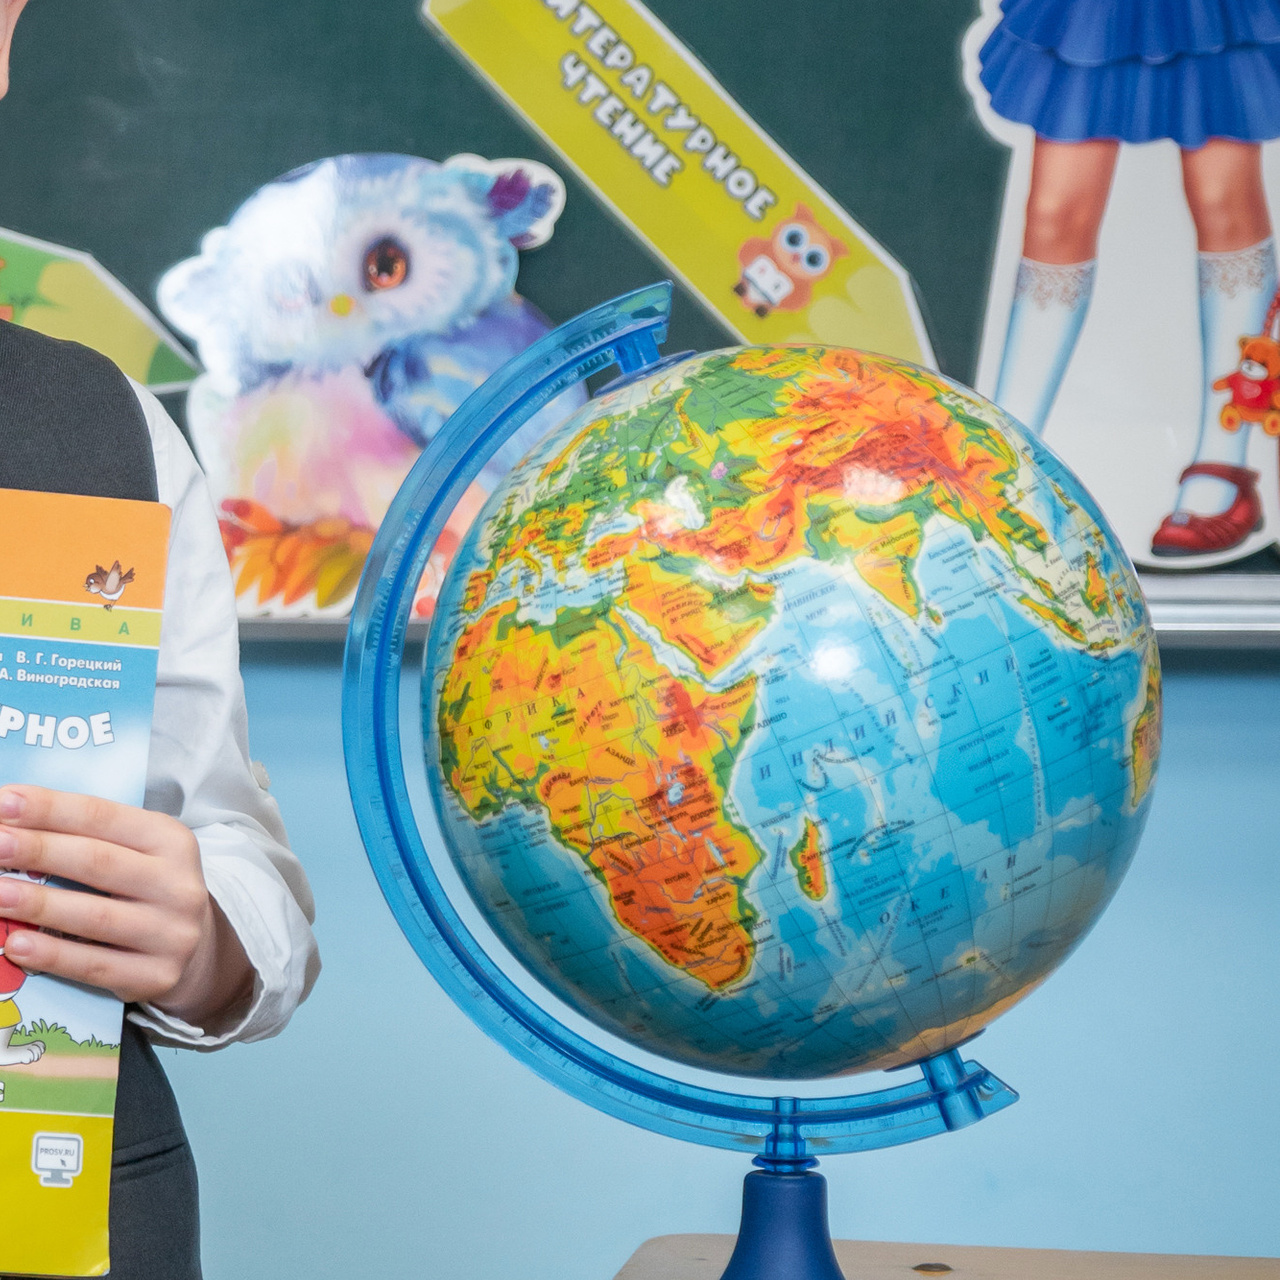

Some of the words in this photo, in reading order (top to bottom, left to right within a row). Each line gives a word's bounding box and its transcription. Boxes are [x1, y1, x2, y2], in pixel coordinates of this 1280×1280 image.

[559, 51, 684, 187] ЧТЕНИЕ
[16, 651, 29, 664] В.
[35, 652, 47, 665] Г.
[51, 653, 122, 672] Горецкий
[17, 669, 120, 690] Виноградская
